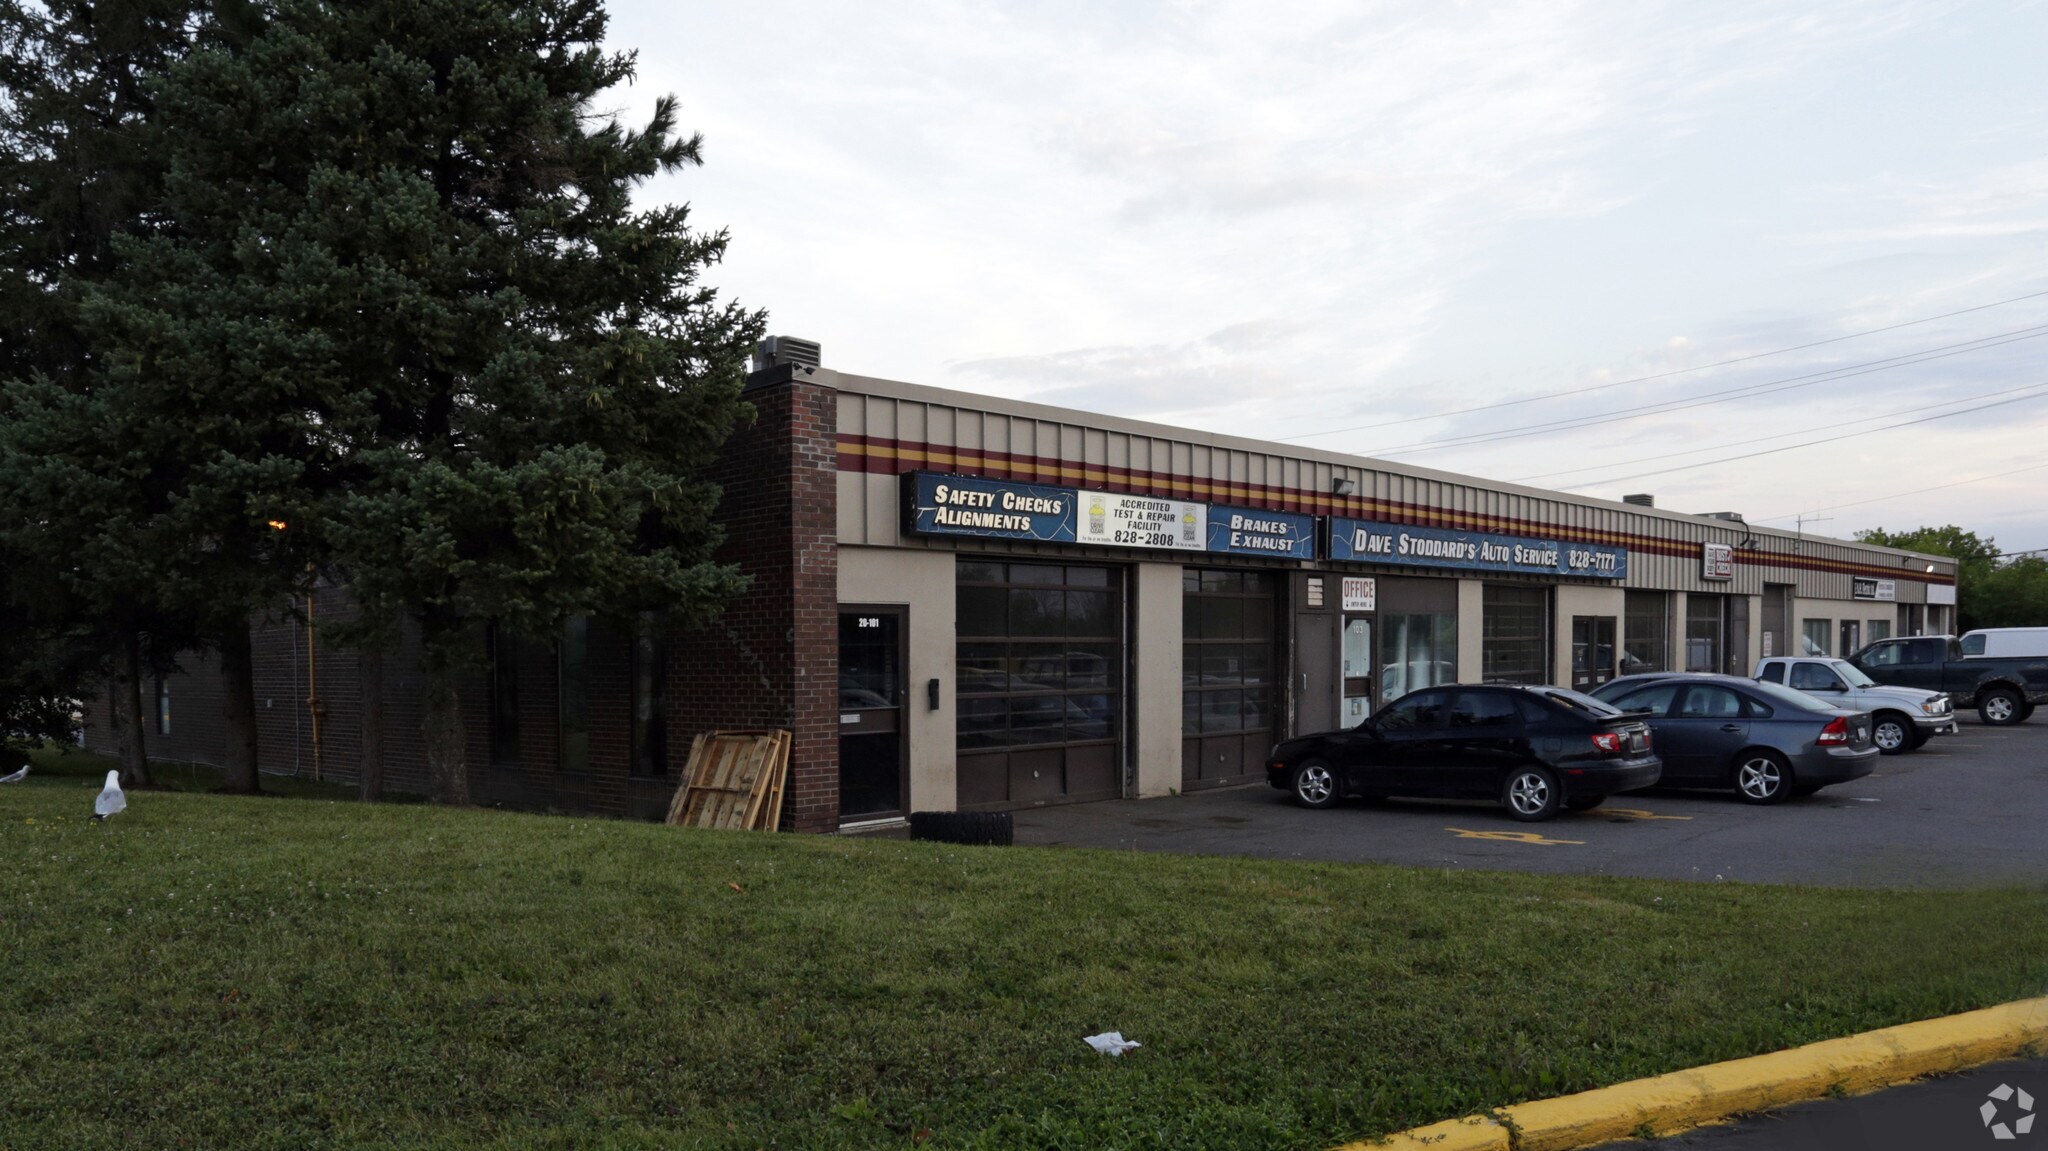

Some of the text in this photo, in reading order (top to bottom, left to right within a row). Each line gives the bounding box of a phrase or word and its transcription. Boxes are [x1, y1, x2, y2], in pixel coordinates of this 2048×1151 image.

[935, 485, 1062, 514] SAFETY CHECKS
[1120, 499, 1170, 512] ACCREDITED
[935, 506, 1030, 531] ALIGNMENTS
[1114, 509, 1175, 522] TEST & REPAIR
[1230, 514, 1288, 534] BRAKES
[1127, 520, 1162, 531] FACILITY
[1114, 530, 1174, 546] 828-2808
[1230, 531, 1294, 551] EXHAUST
[1354, 528, 1616, 570] DAVE STODDARD'S AUTO SERVICE 828-7171
[1344, 580, 1373, 598] OFFICE
